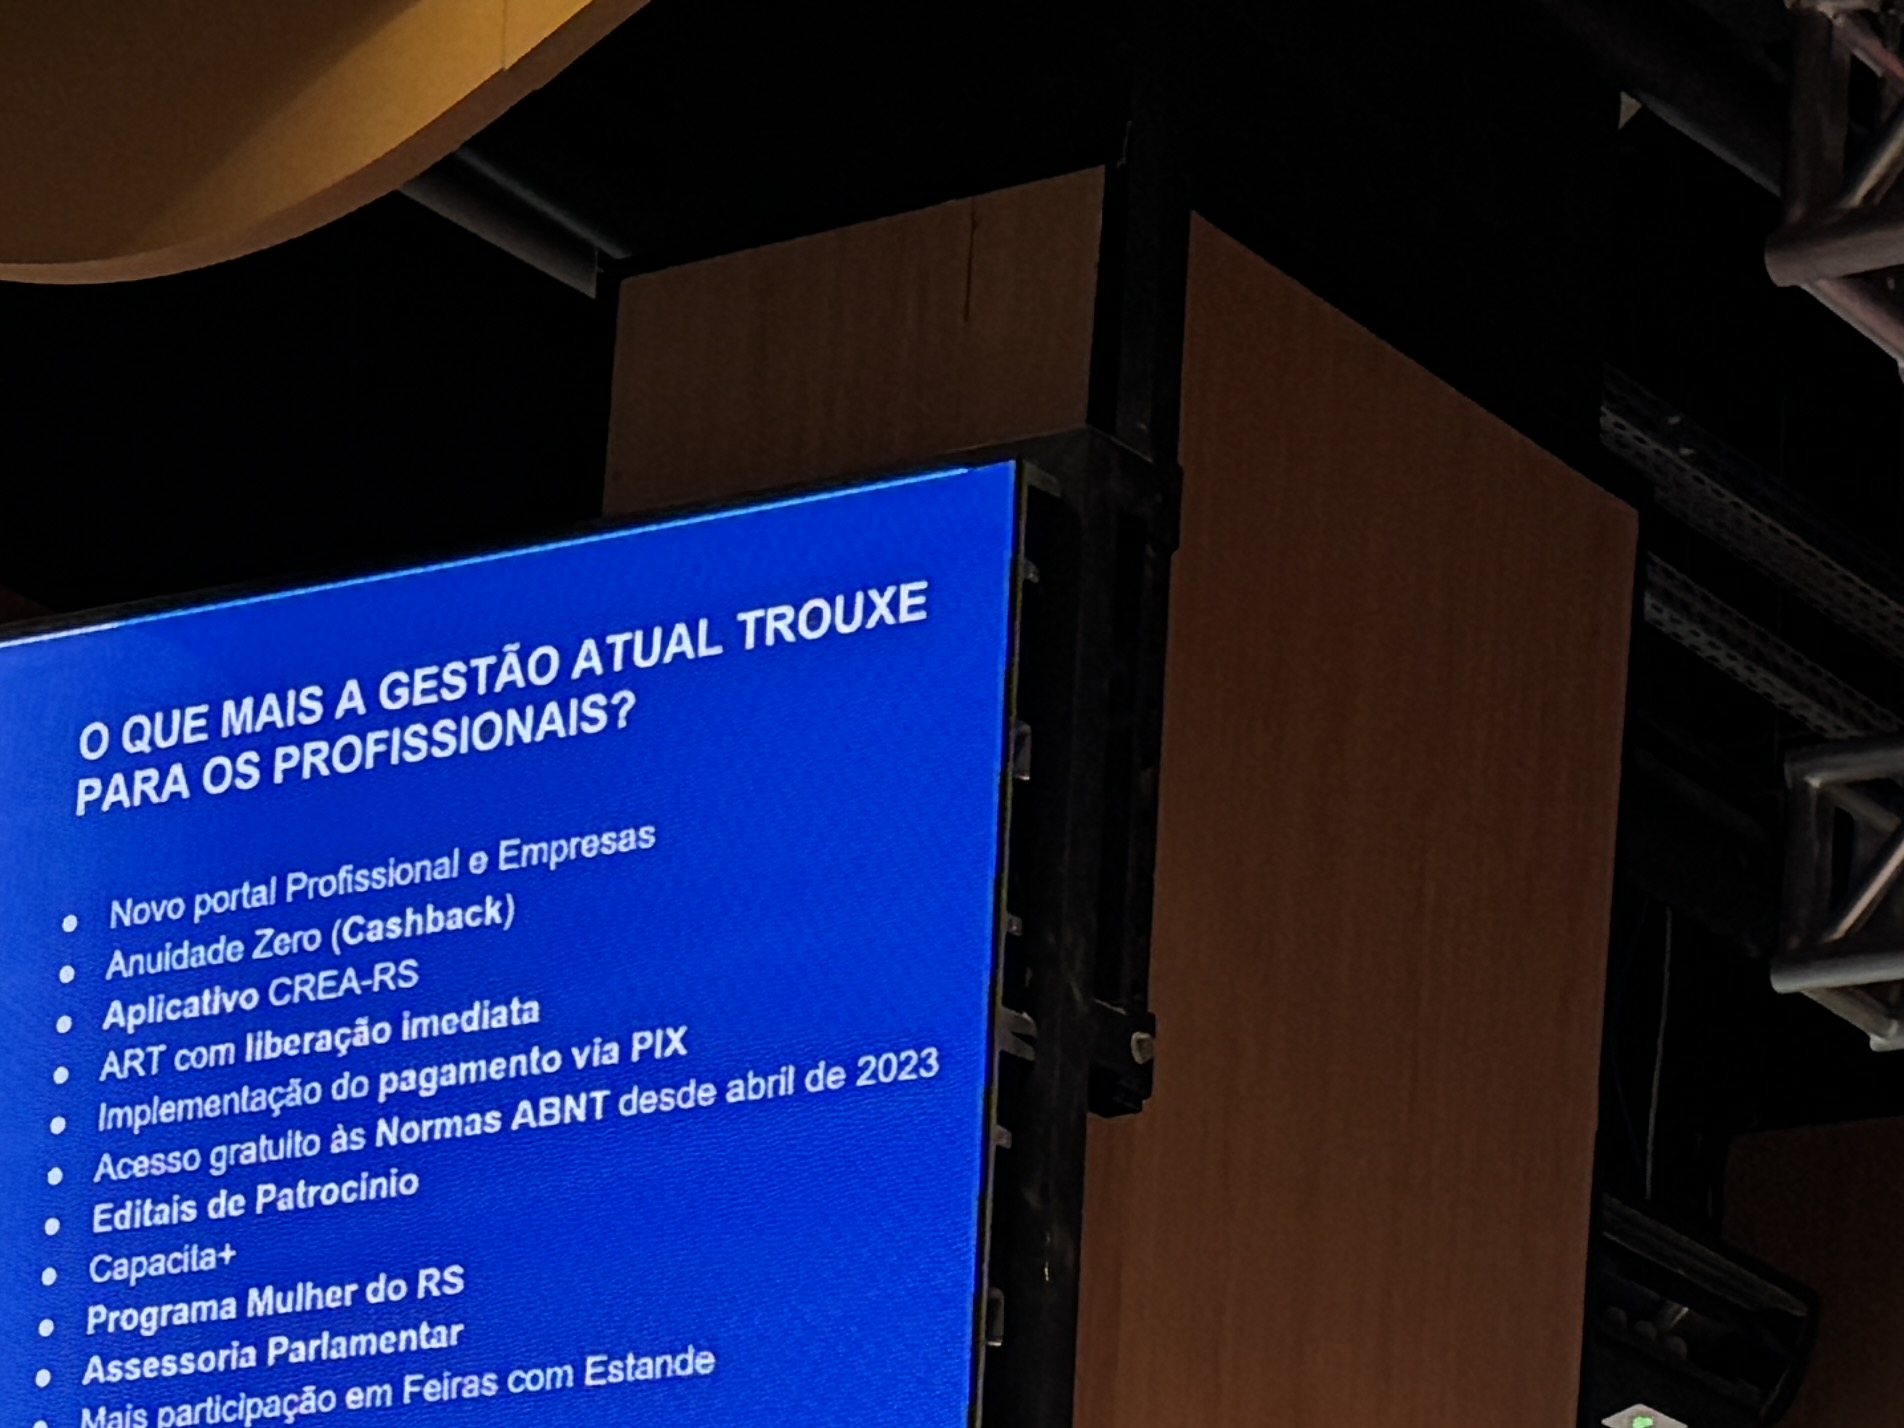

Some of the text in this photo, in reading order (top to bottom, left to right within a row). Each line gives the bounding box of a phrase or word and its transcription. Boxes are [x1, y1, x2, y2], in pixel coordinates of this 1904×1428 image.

[79, 580, 928, 761] O QUE MAIS A GESTÃO ATUAL TROUXE
[76, 689, 636, 816] PARA OS PROFISSIONAIS?
[110, 825, 656, 928] Novo portal Profissional e Empresas
[105, 894, 515, 980] Anuidade Zero (Cashback)
[102, 958, 419, 1035] Aplicativo CREA-RS
[98, 1026, 687, 1135] Implementação do pagamento via PIX
[99, 997, 540, 1081] ART com liberação imediata
[93, 1047, 939, 1183] Acesso gratuito às Normas ABNT desde abril de 2023
[92, 1168, 419, 1233] Editais de Patrocínio
[86, 1264, 465, 1337] Programa Mulher do RS
[89, 1244, 236, 1286] Capacita+
[82, 1321, 465, 1385] Assessoria Parlamentar
[344, 1383, 393, 1410] em
[403, 1372, 498, 1404] Feiras
[507, 1364, 574, 1393] com
[584, 1345, 716, 1387] Estande
